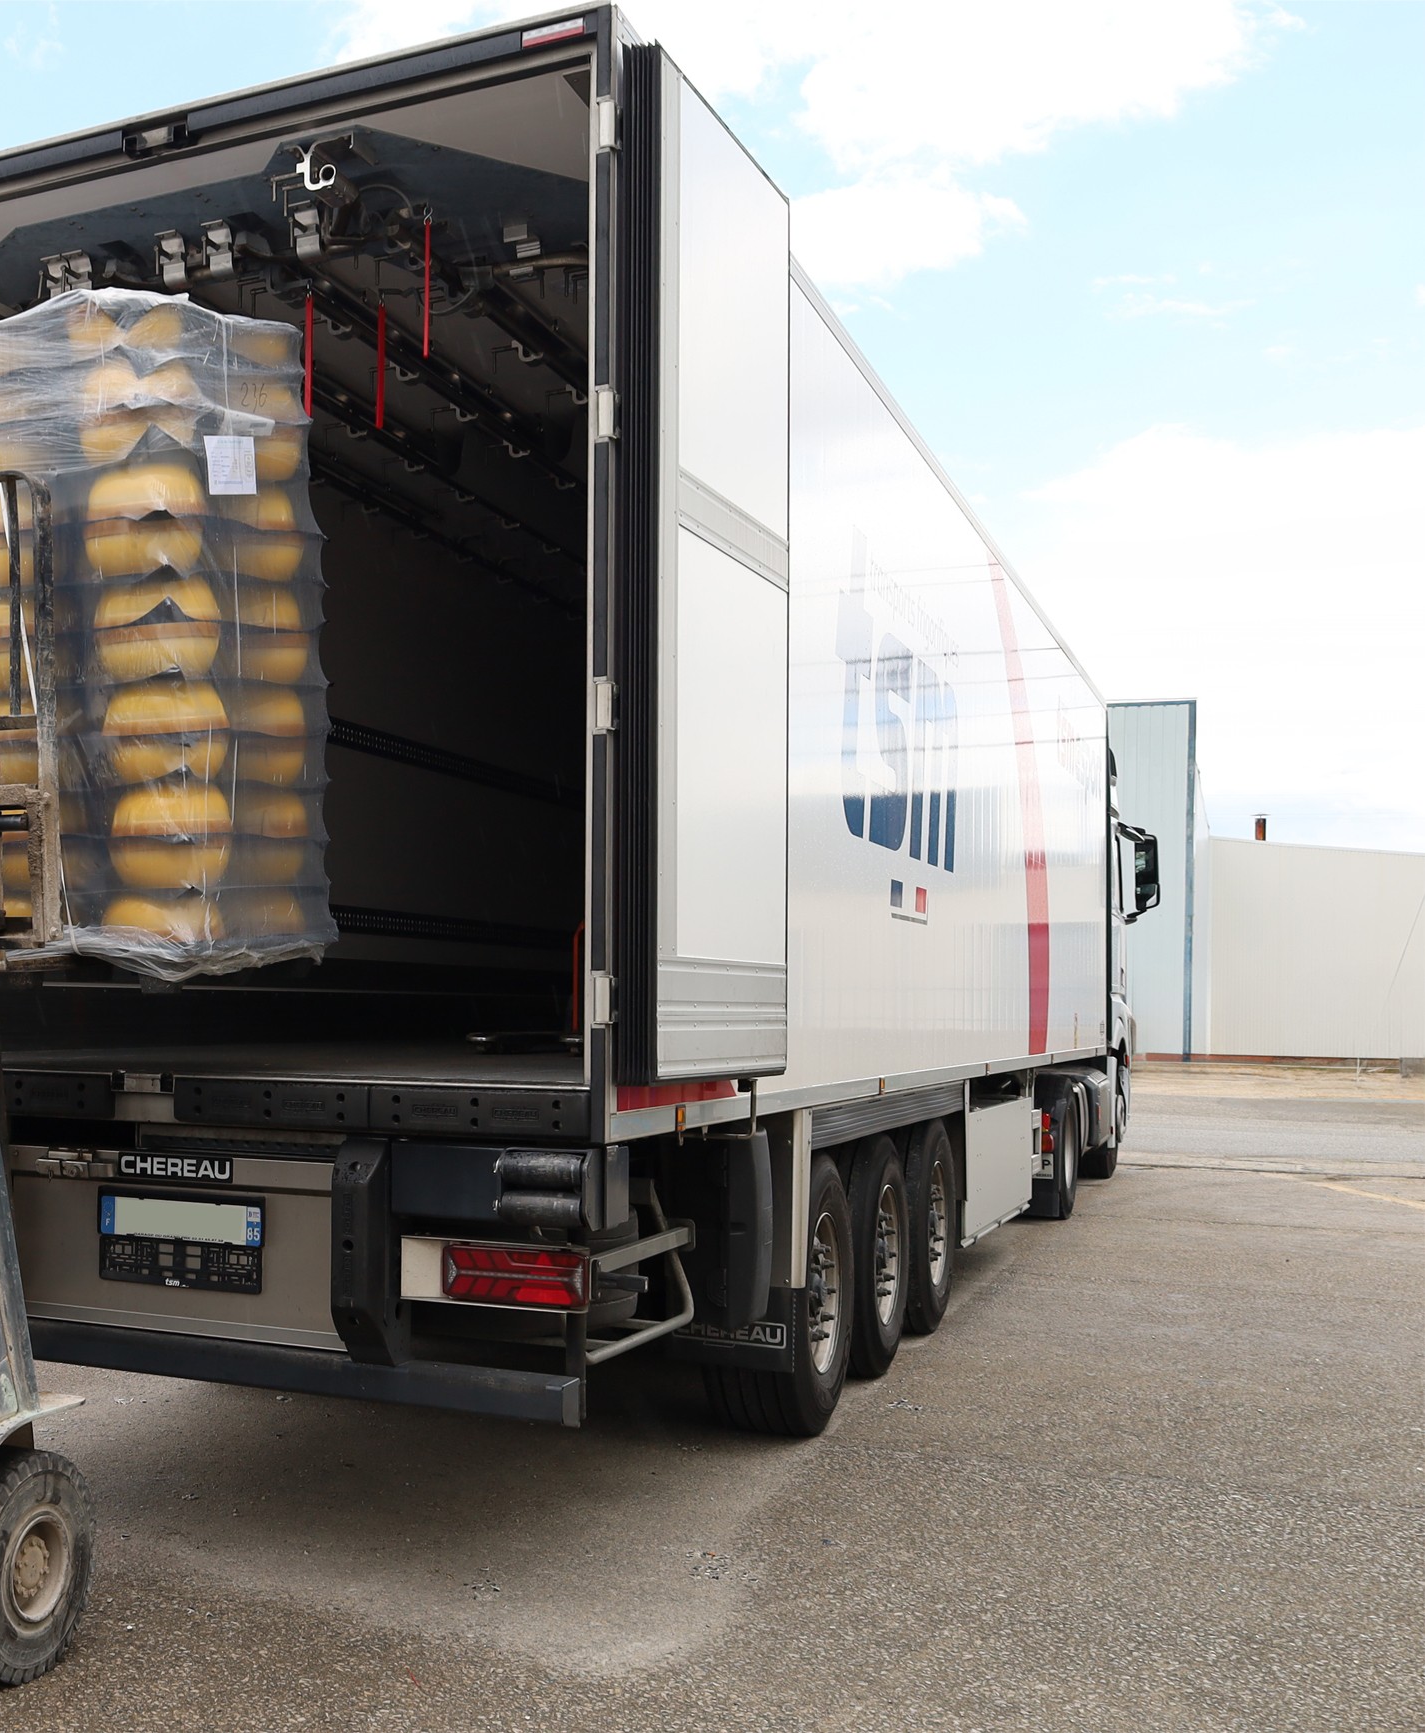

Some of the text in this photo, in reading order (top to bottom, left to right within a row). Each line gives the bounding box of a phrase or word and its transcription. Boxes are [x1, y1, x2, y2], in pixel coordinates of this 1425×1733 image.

[120, 1155, 231, 1180] CHEREAU
[105, 1218, 110, 1226] F
[246, 1227, 261, 1241] 85
[165, 1278, 180, 1287] tsm
